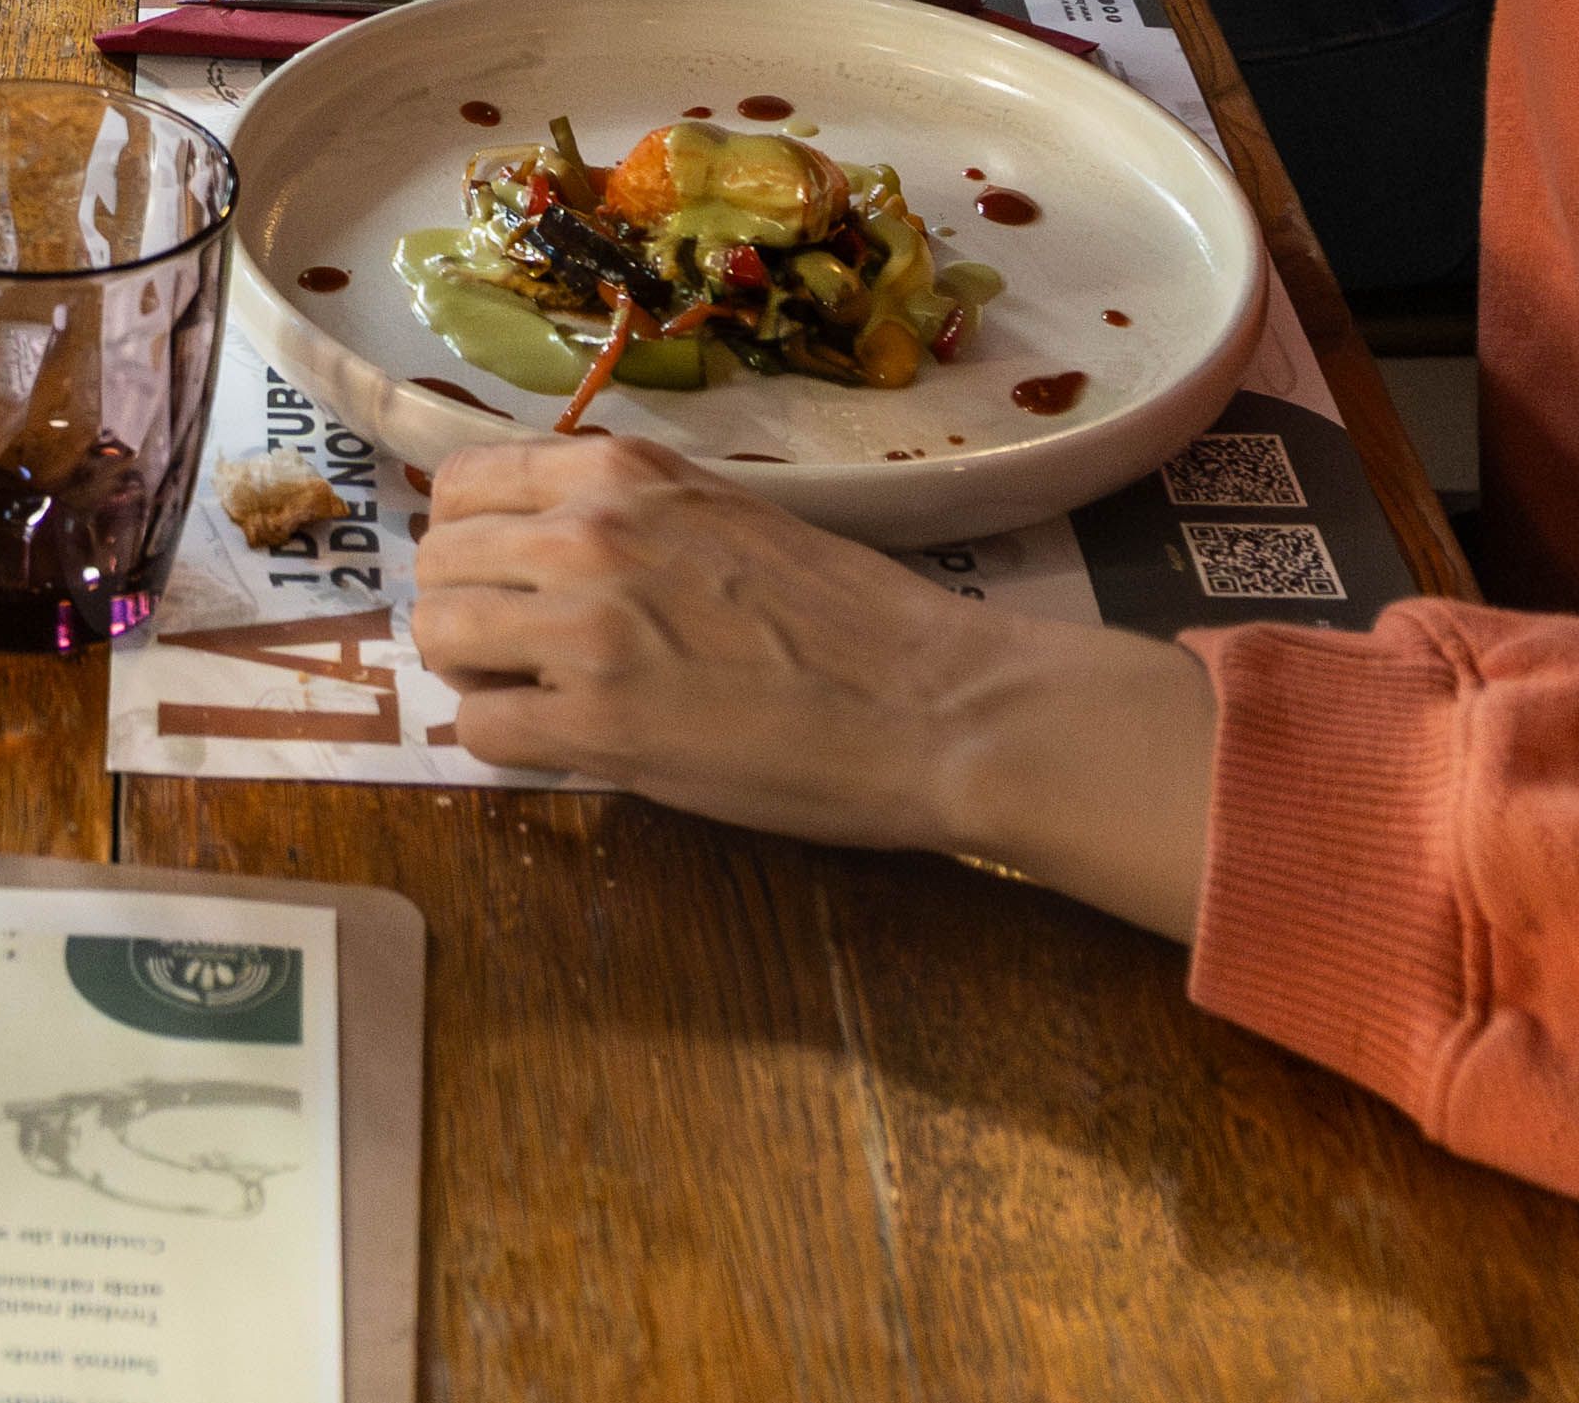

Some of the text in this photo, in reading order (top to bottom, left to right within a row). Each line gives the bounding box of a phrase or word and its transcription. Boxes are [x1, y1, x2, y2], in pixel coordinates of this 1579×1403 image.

[268, 569, 321, 590] 1
[329, 567, 382, 591] 2
[156, 606, 402, 746] LA
